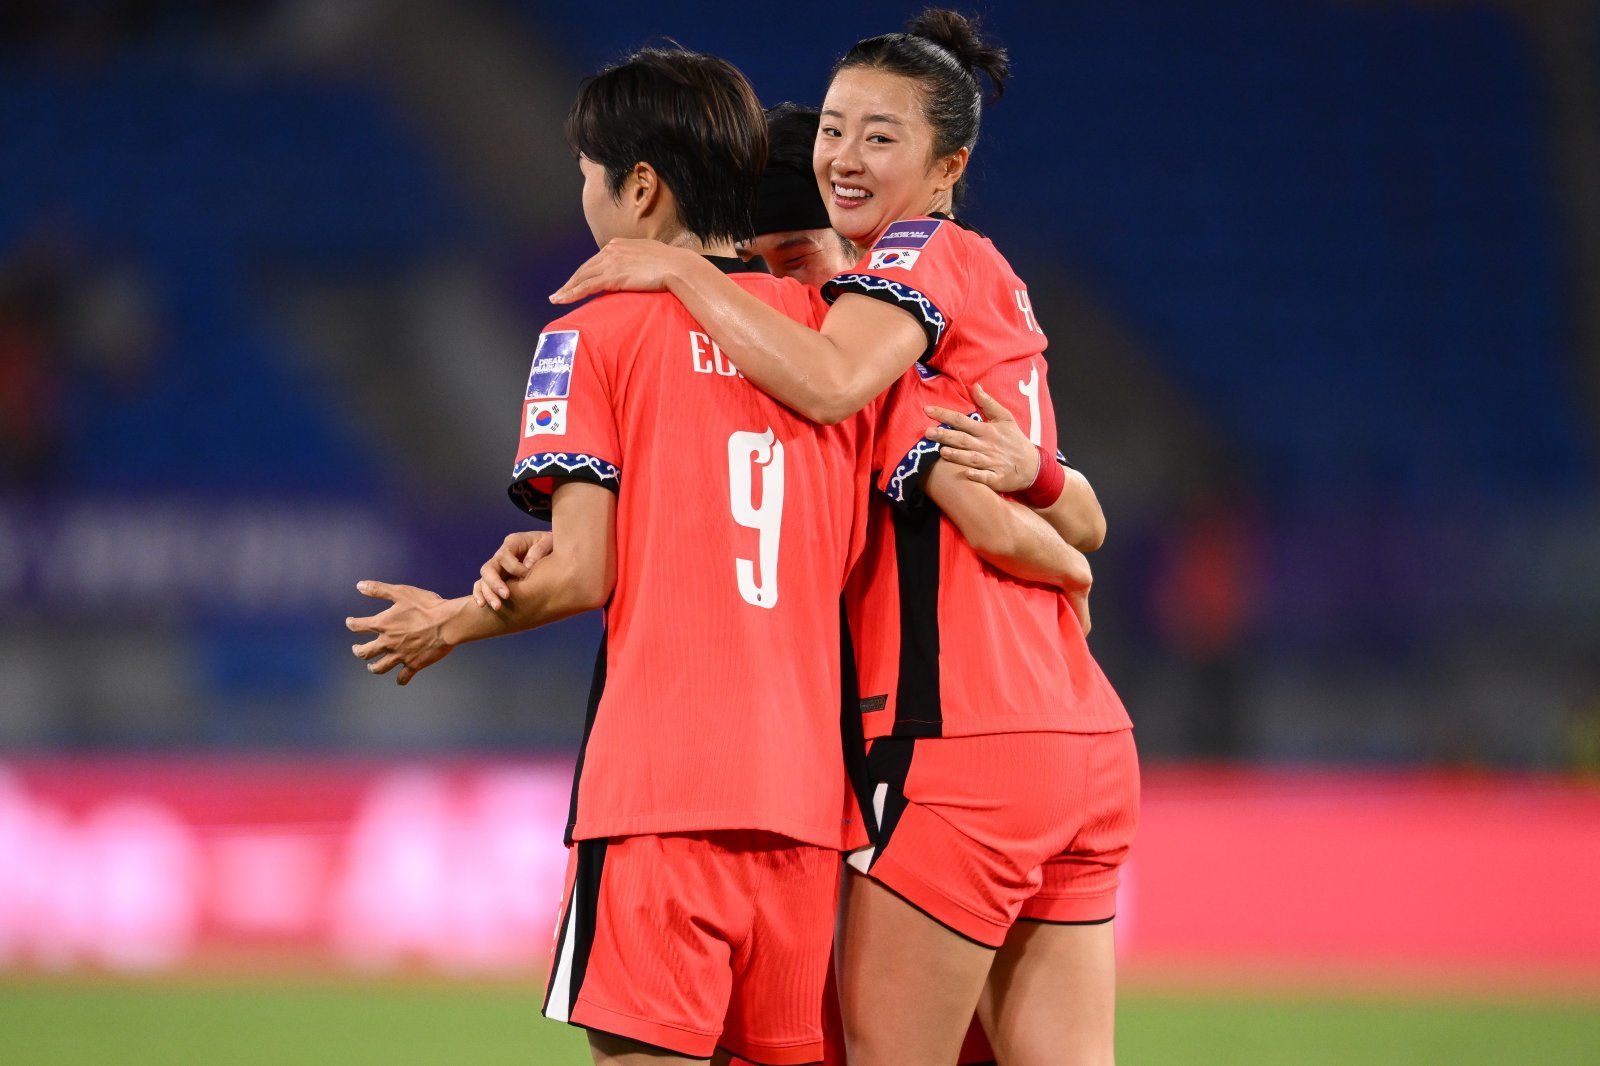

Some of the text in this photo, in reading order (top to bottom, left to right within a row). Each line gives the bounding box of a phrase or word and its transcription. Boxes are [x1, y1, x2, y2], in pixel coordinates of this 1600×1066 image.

[538, 356, 566, 365] DREAM
[689, 330, 744, 379] EU
[727, 425, 785, 609] 9
